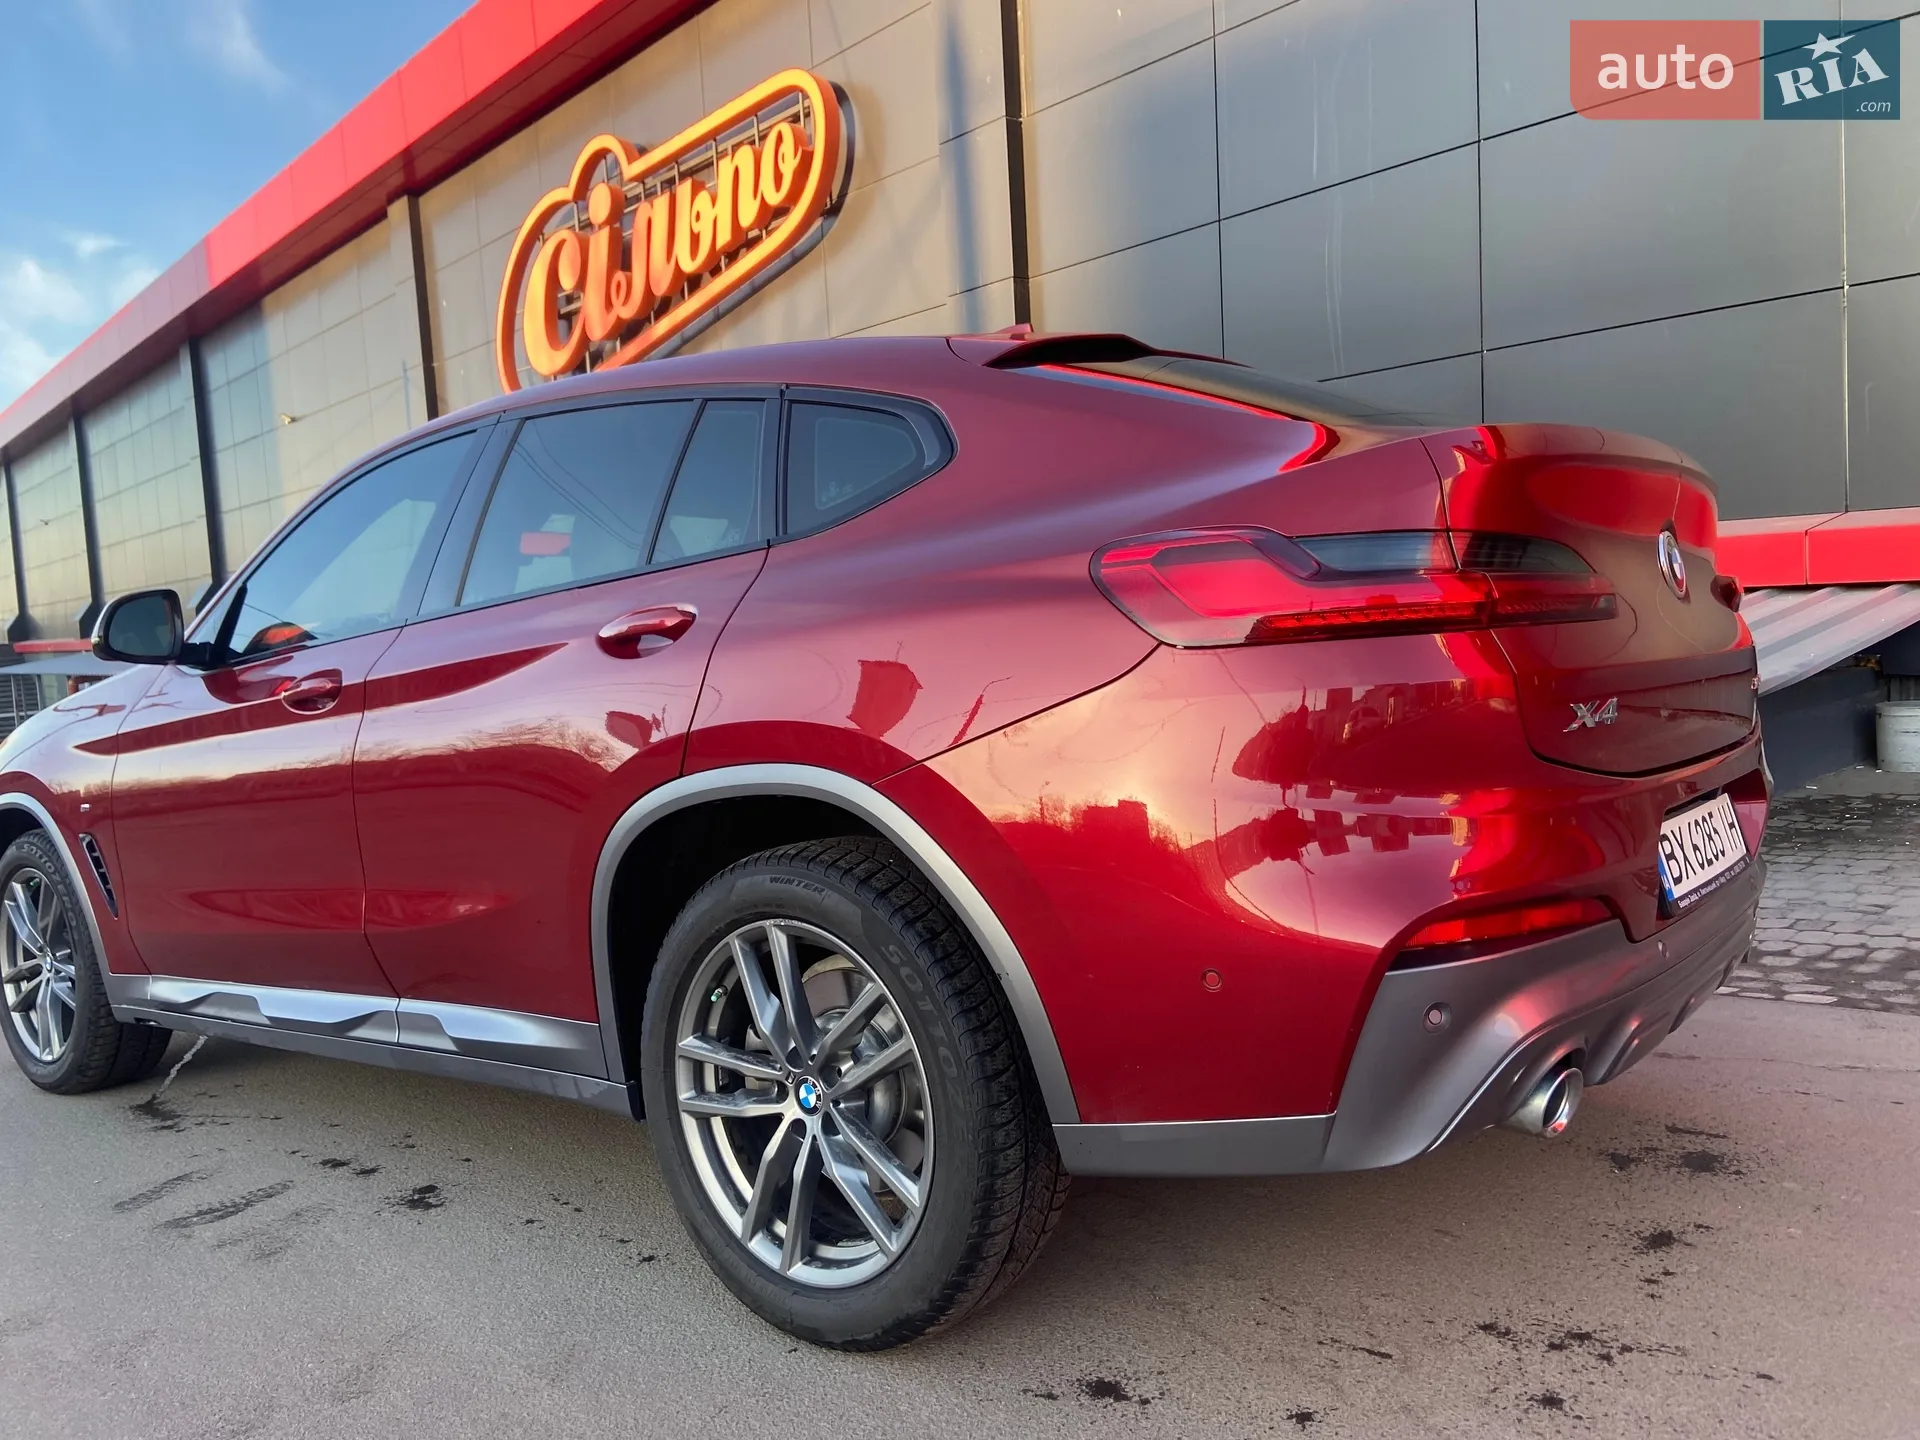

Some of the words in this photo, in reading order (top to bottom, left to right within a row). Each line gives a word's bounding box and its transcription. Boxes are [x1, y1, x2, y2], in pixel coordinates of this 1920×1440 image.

[523, 121, 806, 376] Сільпо
[1562, 696, 1619, 732] X4
[1660, 826, 1697, 886] BX
[1687, 811, 1726, 871] 6285
[769, 875, 826, 896] WINTER
